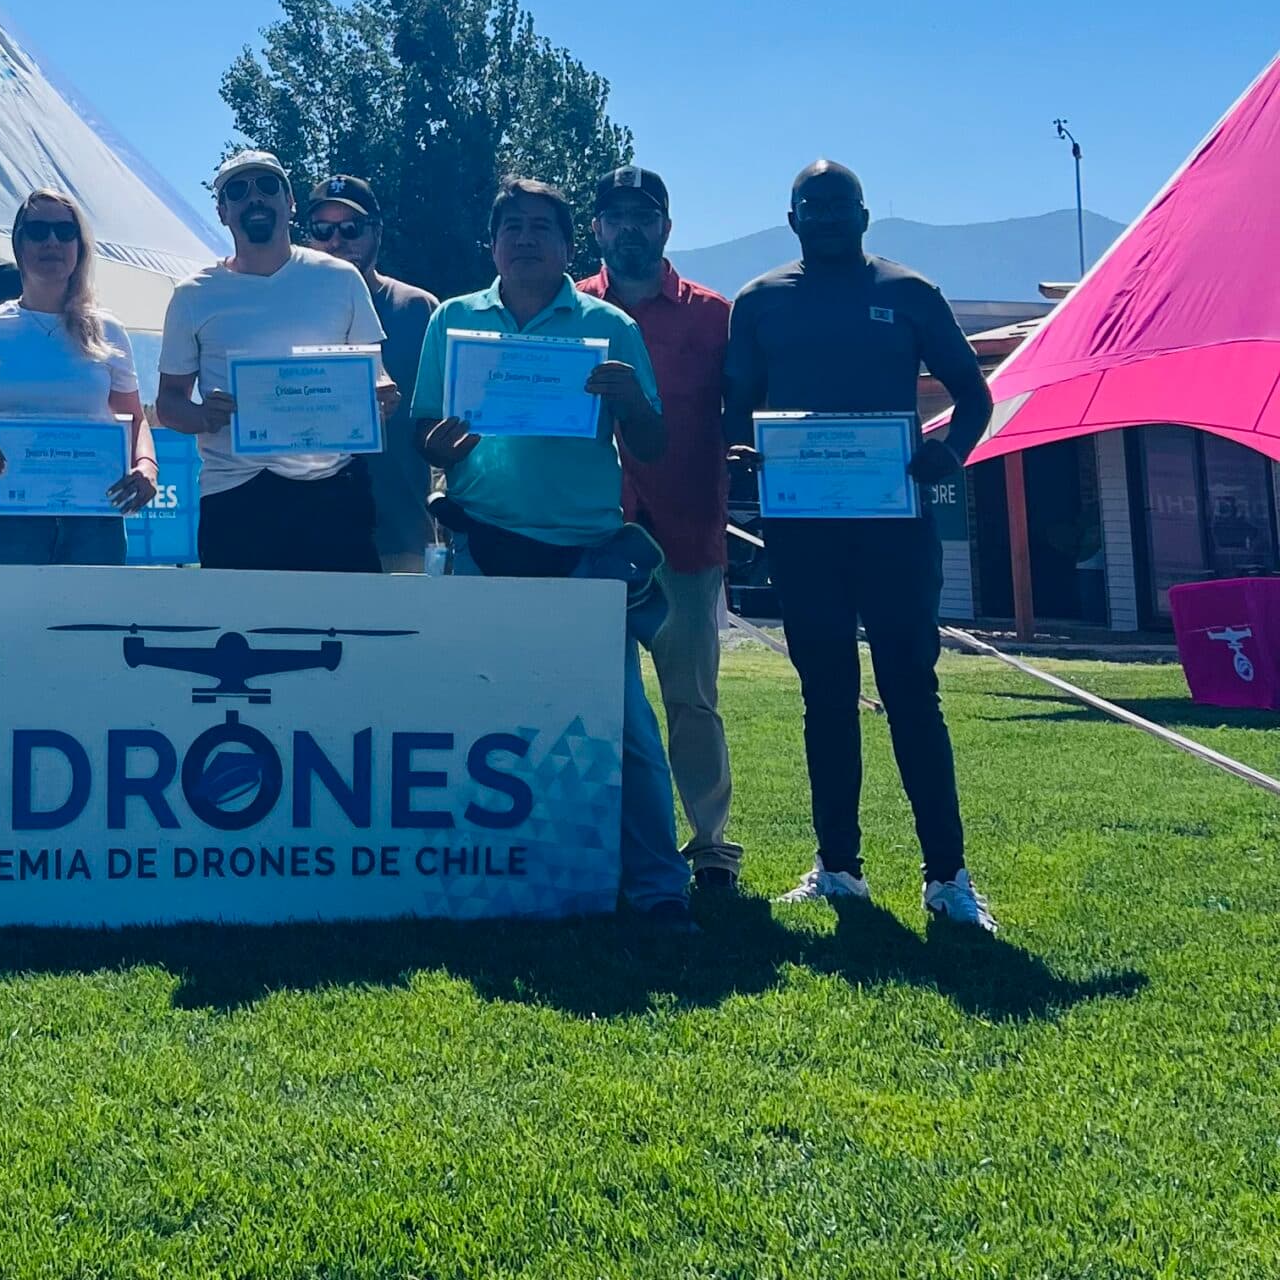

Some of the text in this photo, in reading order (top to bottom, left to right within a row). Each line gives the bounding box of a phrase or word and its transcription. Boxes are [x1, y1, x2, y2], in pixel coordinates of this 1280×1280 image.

[108, 847, 157, 880] DE
[174, 846, 336, 878] DRONES
[351, 846, 401, 876] DE
[415, 845, 529, 876] CHILE
